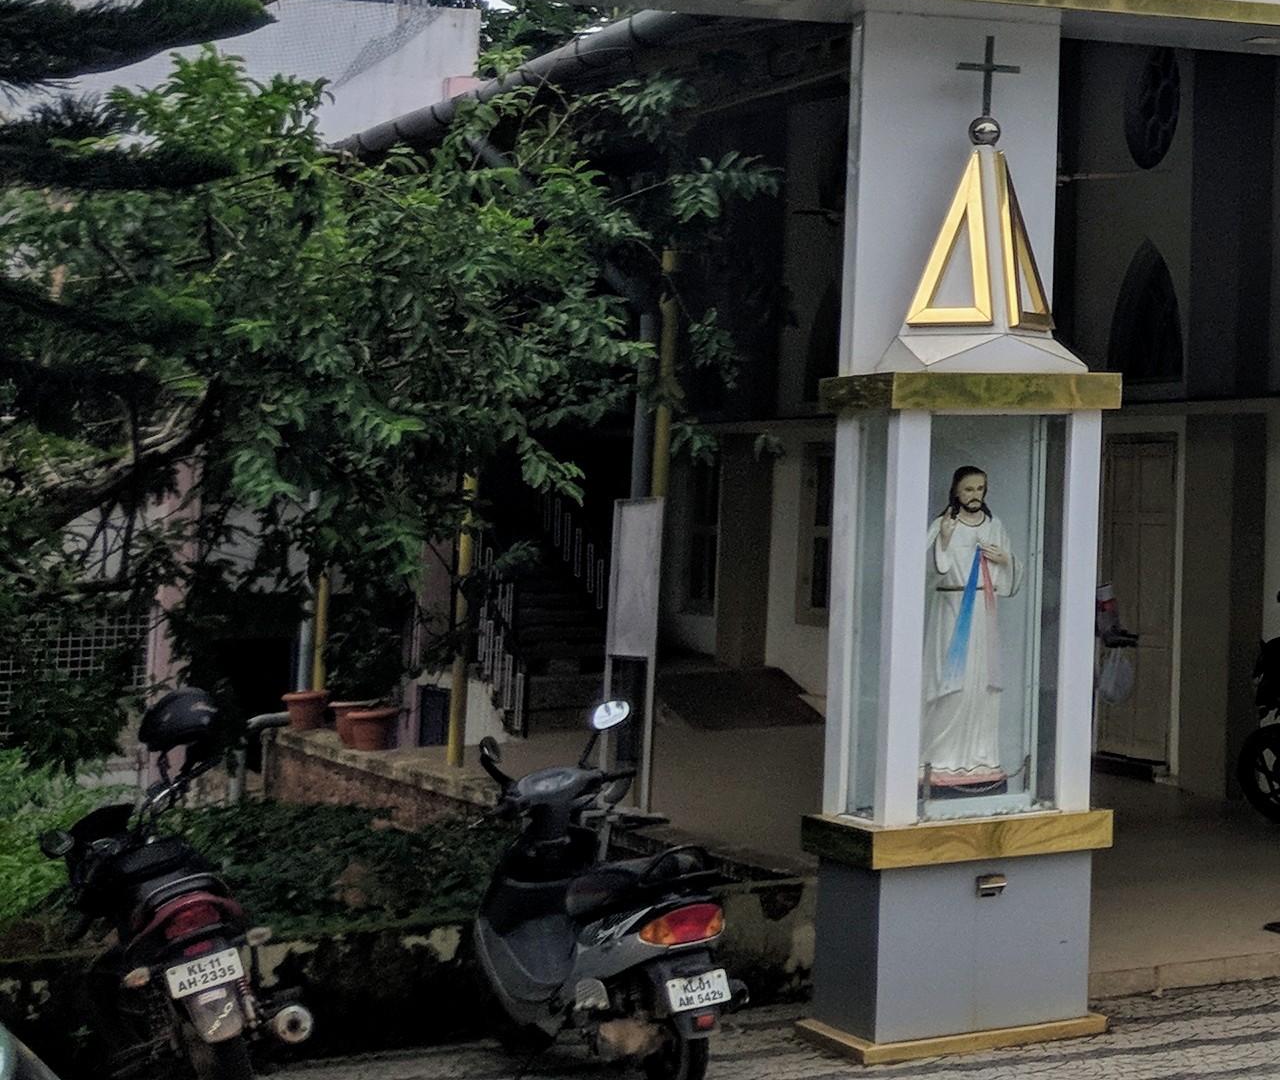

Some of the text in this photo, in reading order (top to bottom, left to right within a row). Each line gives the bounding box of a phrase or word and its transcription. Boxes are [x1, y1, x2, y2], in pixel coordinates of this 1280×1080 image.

[187, 957, 221, 976] KL-11
[178, 965, 236, 992] AH-2335
[679, 990, 723, 1007] AM 5429
